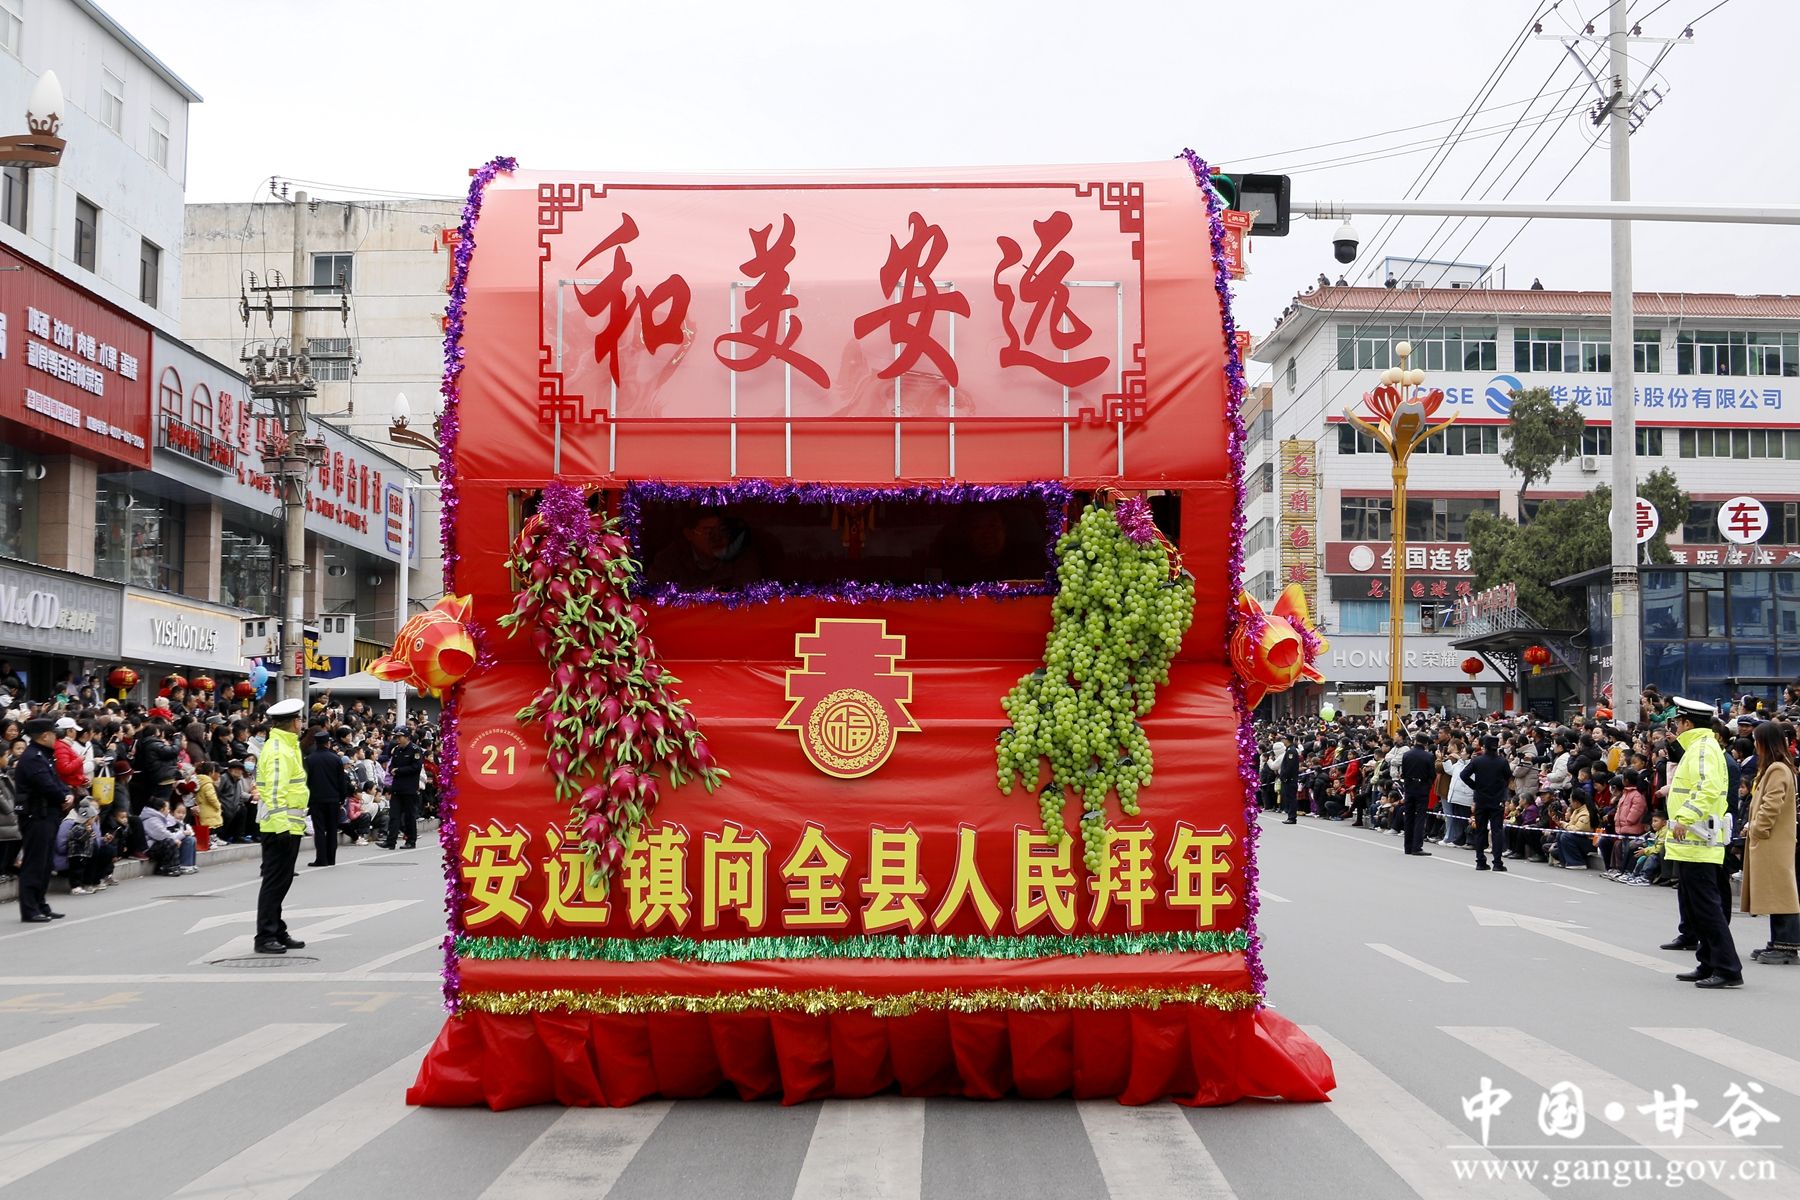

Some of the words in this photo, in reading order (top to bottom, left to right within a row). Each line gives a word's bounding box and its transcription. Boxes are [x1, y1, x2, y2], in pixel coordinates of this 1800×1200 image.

[574, 211, 1111, 390] 和美安远
[54, 318, 73, 351] 饮料
[100, 342, 117, 371] 水果
[1412, 387, 1474, 404] CSE
[1549, 385, 1782, 410] 华龙证股份有限公司
[1288, 455, 1314, 607] 名爵台球
[1670, 549, 1800, 565] 舞蹈艺术
[1367, 579, 1473, 598] 名台球俱
[1421, 651, 1459, 668] 荣耀
[480, 744, 515, 775] 21
[461, 823, 1234, 931] 安远镇向全县人民拜年
